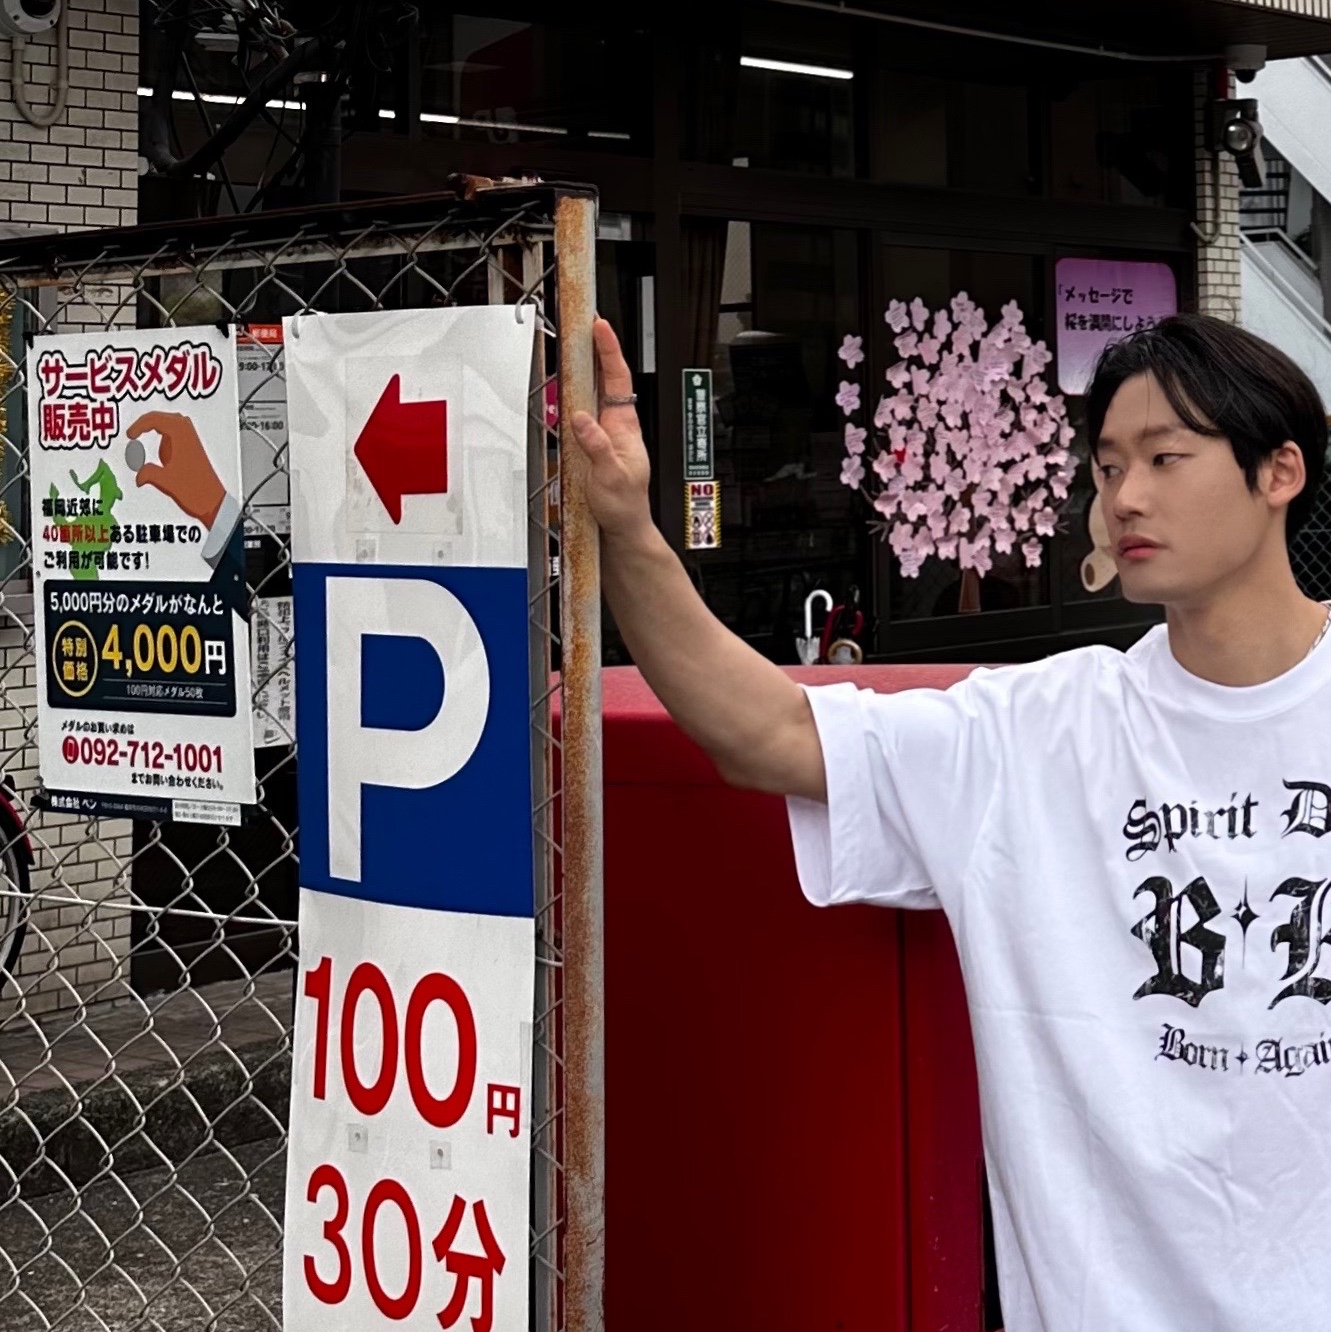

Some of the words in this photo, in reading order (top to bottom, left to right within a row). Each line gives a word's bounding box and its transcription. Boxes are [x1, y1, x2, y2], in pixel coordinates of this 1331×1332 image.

[41, 350, 218, 397] サービスメダル
[42, 400, 115, 442] 販売中
[691, 483, 714, 496] NO
[50, 591, 224, 616] 5,000円分のメダルがなんと
[61, 637, 87, 658] 特別
[101, 623, 227, 679] 4,000円
[62, 661, 89, 682] 価格
[326, 576, 491, 883] P
[80, 736, 223, 773] 092-712-1001
[1123, 792, 1259, 861] Spirit
[1130, 875, 1227, 1009] B
[304, 956, 522, 1139] 100円
[1154, 1022, 1230, 1072] Born
